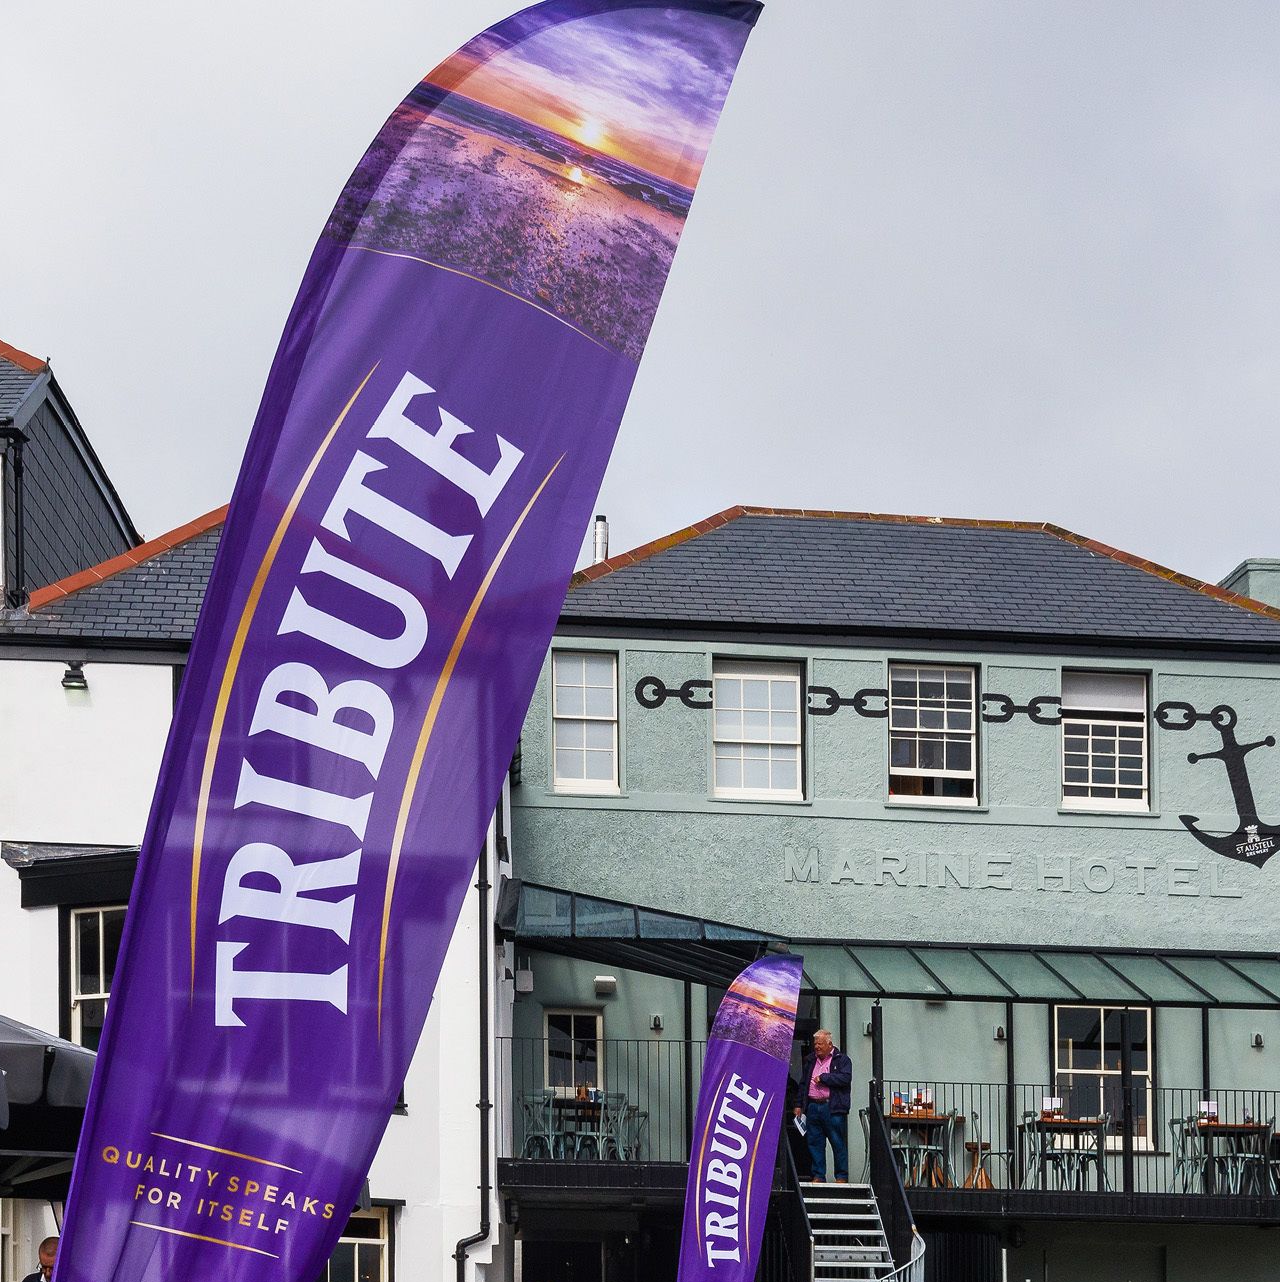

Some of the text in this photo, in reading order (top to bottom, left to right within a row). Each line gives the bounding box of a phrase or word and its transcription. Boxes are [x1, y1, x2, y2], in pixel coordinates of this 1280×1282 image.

[215, 371, 525, 1028] TRIBUTE
[784, 846, 1243, 899] MARINE HOTEL
[1245, 840, 1275, 852] AUSTELL
[102, 1145, 336, 1220] QUALITY SPEAKS
[705, 1072, 766, 1268] TRIBUTE
[134, 1184, 289, 1234] FOR ITSELF
